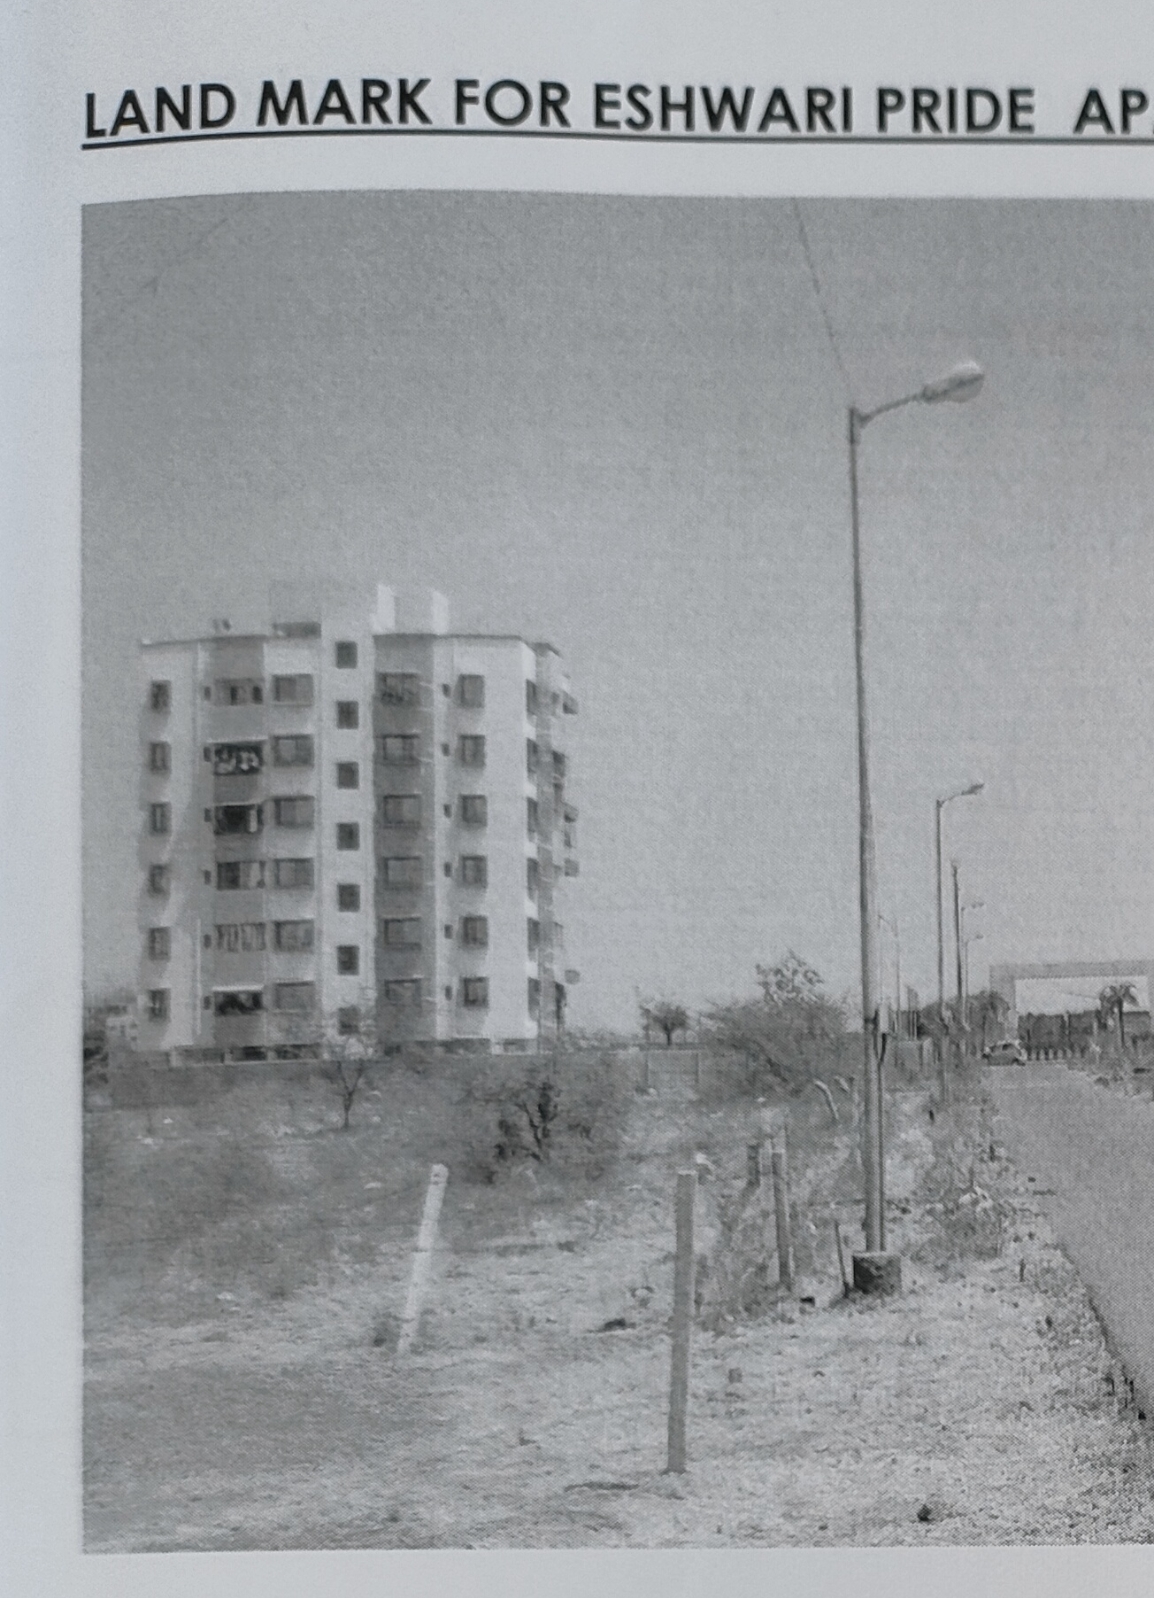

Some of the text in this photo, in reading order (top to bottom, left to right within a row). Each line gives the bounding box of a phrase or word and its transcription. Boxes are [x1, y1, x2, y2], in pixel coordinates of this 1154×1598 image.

[85, 82, 237, 139] LAND
[255, 77, 434, 127] MARK
[453, 77, 572, 128] FOR
[593, 82, 854, 134] ESHWARI
[875, 86, 1036, 135] PRIDE
